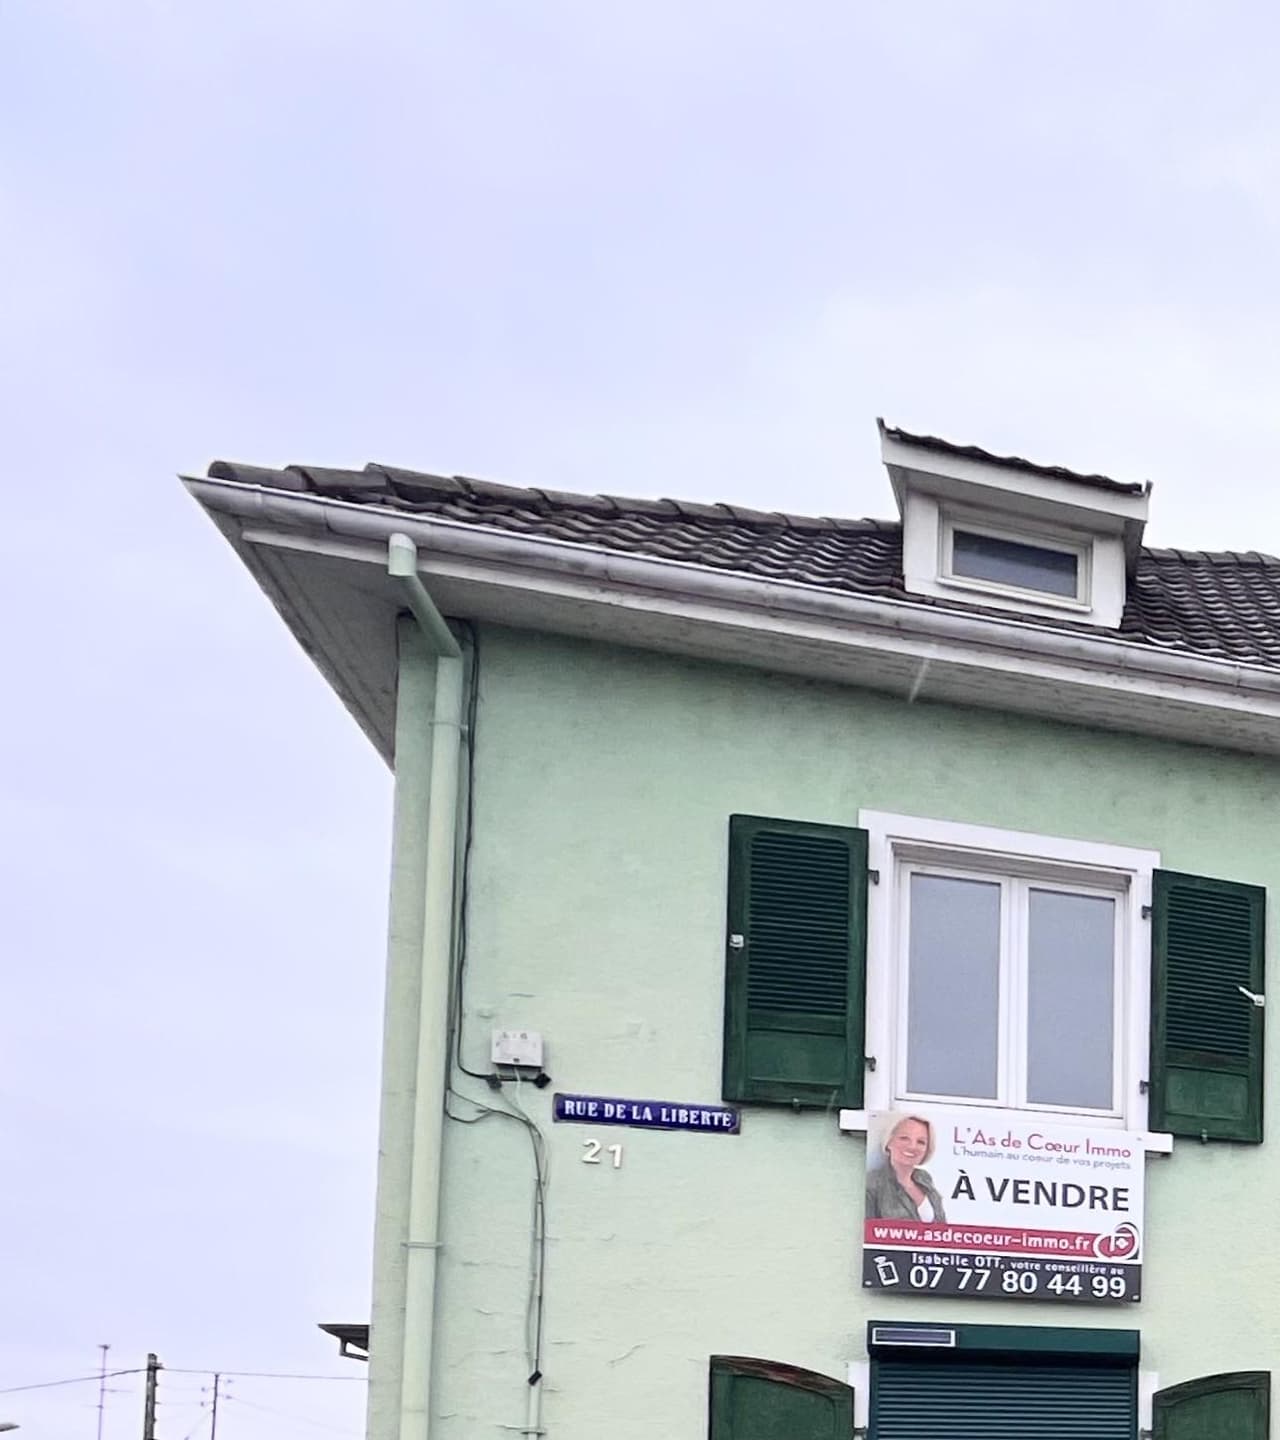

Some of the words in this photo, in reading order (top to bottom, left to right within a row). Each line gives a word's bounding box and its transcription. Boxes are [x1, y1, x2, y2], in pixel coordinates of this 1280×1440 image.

[564, 1100, 598, 1117] RUE
[604, 1103, 626, 1119] DE
[632, 1105, 652, 1121] LA
[661, 1107, 732, 1127] LIBERTE
[582, 1138, 623, 1169] 21
[953, 1126, 996, 1146] L'As
[1000, 1131, 1022, 1149] de
[1085, 1138, 1132, 1158] Immo
[1006, 1151, 1020, 1161] au
[1055, 1154, 1070, 1165] de
[1072, 1157, 1091, 1167] vos
[1093, 1158, 1131, 1170] projets
[951, 1169, 976, 1201] À
[985, 1176, 1129, 1212] VENDRE
[874, 1227, 1090, 1250] www.asdecoeur-immo.fr
[912, 1253, 969, 1266] Isabelle
[1010, 1261, 1041, 1271] votre
[1045, 1263, 1107, 1275] conseillère
[910, 1266, 944, 1288] 07
[956, 1268, 991, 1290] 77
[1002, 1270, 1038, 1293] 80
[1046, 1273, 1083, 1296] 44
[1092, 1276, 1126, 1298] 99
